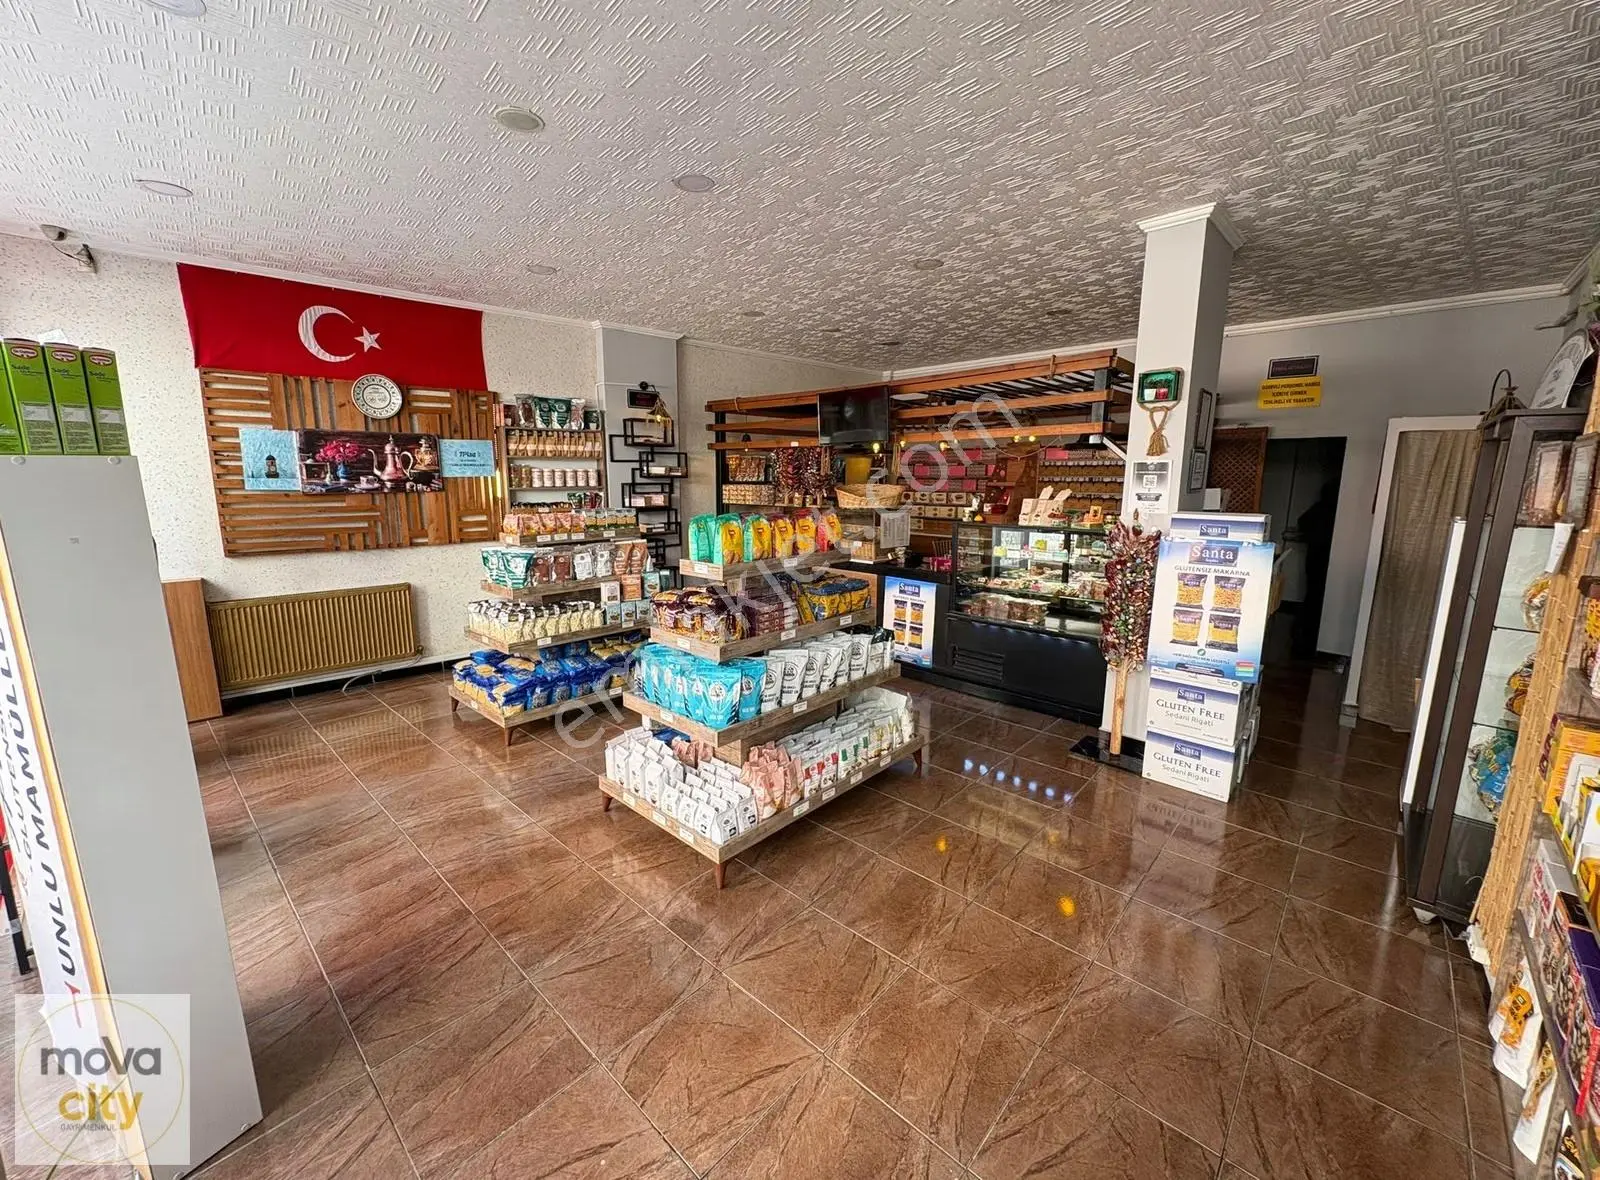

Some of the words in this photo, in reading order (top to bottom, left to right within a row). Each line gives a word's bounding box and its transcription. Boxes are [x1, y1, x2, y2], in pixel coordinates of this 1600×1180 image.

[1200, 525, 1228, 535] Santa
[1191, 544, 1235, 560] Santa
[1213, 567, 1251, 577] MAKARNA
[1177, 687, 1203, 700] Santa
[1156, 698, 1196, 716] GLUTEN
[1199, 707, 1225, 721] FREE
[1165, 710, 1190, 721] Sedani
[1191, 715, 1214, 728] Rigati
[1174, 742, 1200, 756] Santa
[1153, 751, 1192, 769] GLUTEN
[1195, 763, 1221, 779] FREE
[1162, 763, 1187, 776] Sedani
[1187, 771, 1210, 783] Rigati
[40, 861, 77, 977] UNLU
